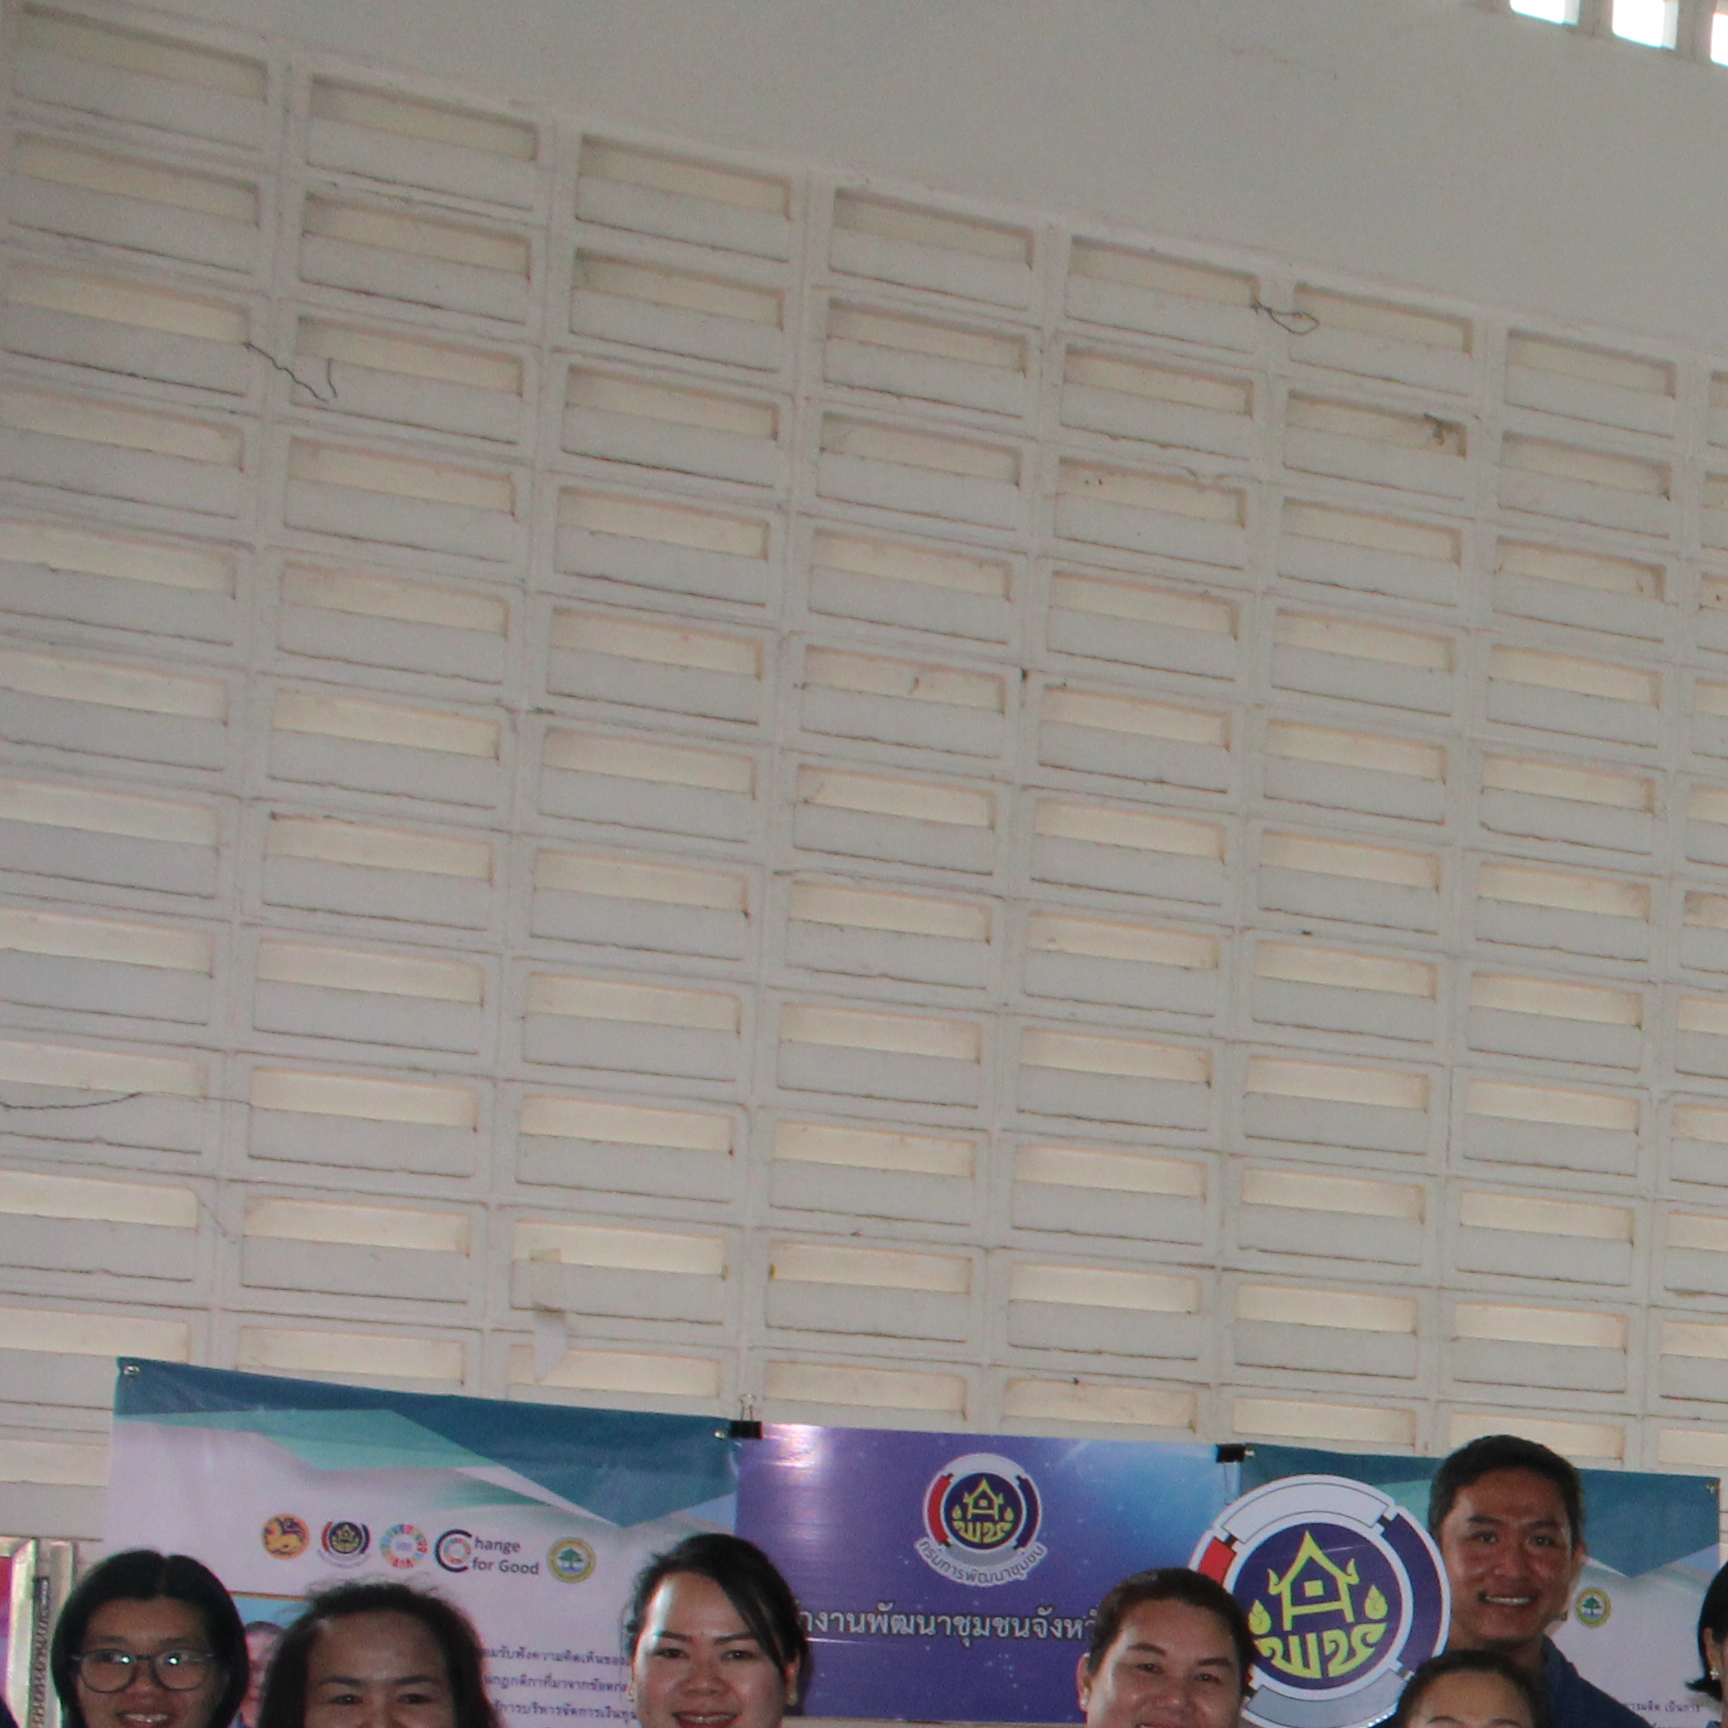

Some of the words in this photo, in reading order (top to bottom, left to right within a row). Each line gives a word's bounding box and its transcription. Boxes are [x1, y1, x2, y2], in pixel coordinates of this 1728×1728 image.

[472, 1558, 494, 1571] for
[499, 1559, 540, 1576] Good
[917, 1541, 1047, 1586] กรมการพัฒนาชุมชน
